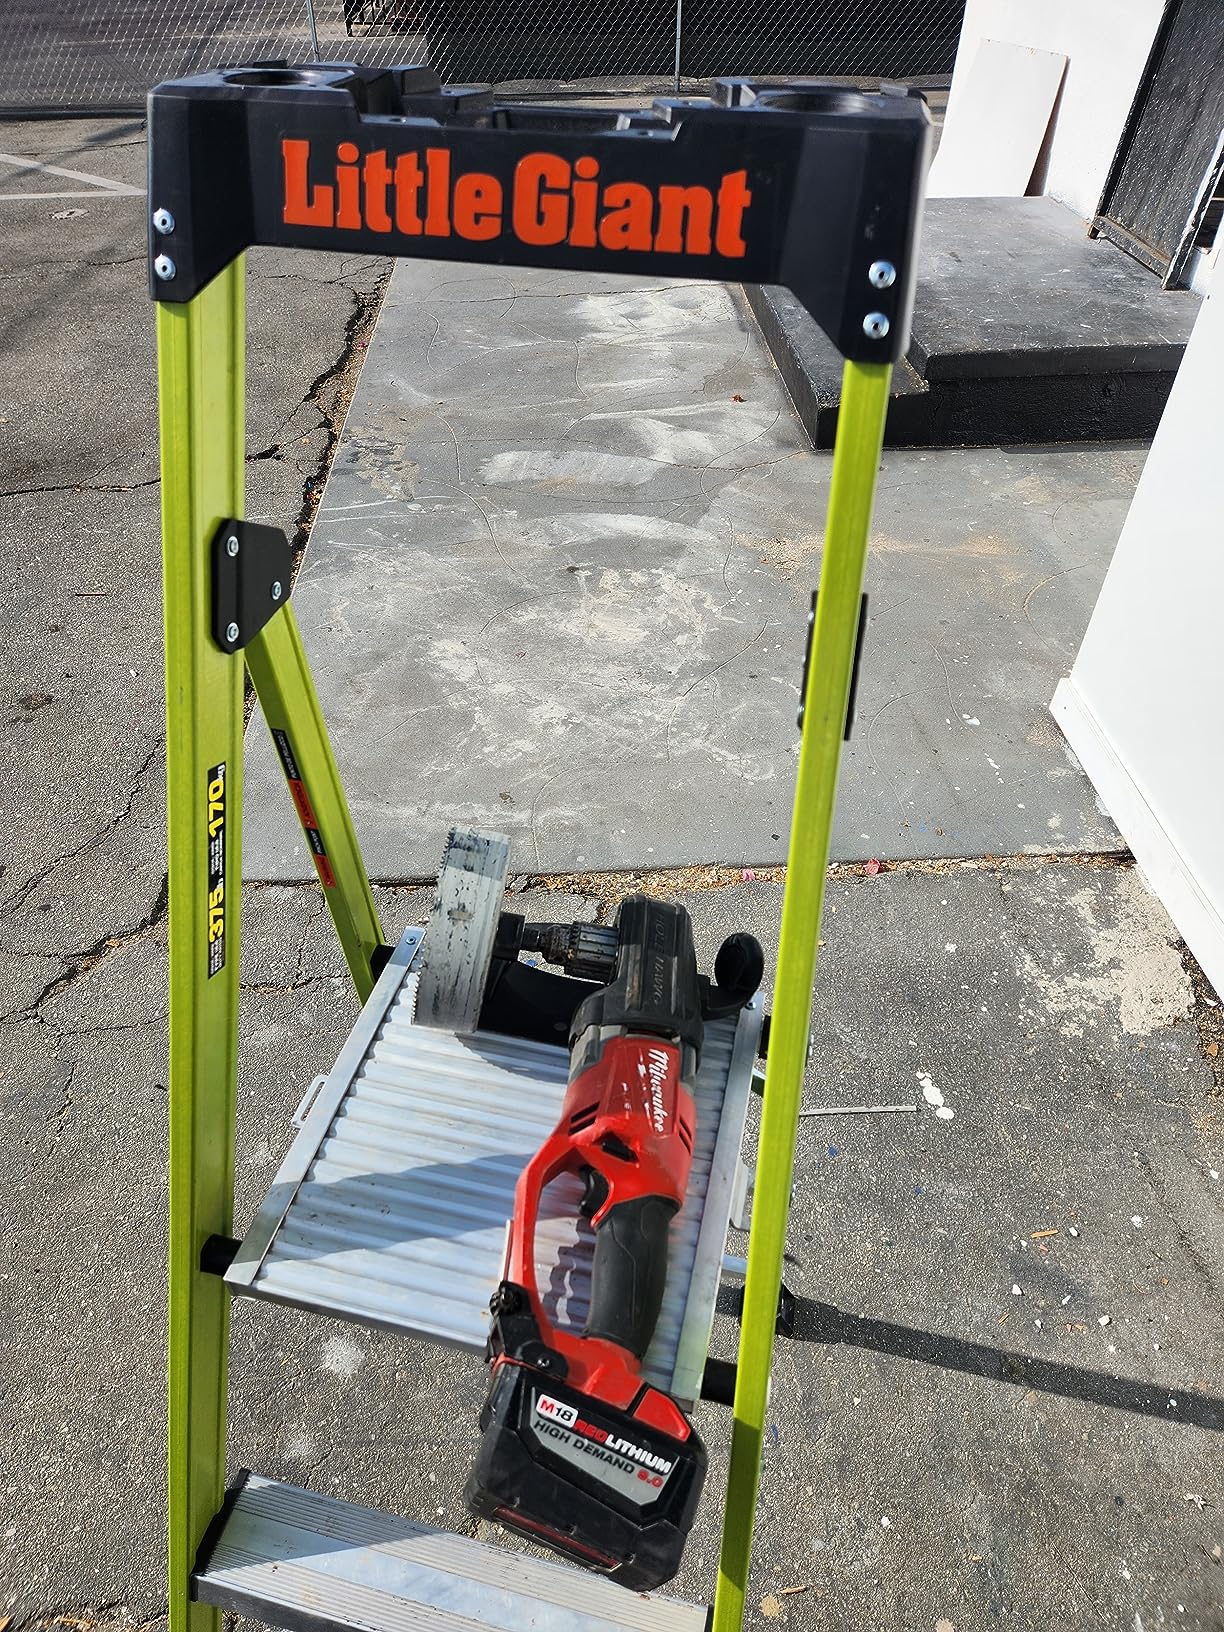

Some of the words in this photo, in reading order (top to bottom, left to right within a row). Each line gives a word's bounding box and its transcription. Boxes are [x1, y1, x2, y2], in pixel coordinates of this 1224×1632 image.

[282, 139, 503, 242] Little
[512, 152, 752, 258] Giant
[649, 1048, 670, 1133] Milwaukee
[540, 1399, 574, 1422] M18
[534, 1421, 571, 1444] HIGH
[572, 1439, 635, 1475] DEMAND
